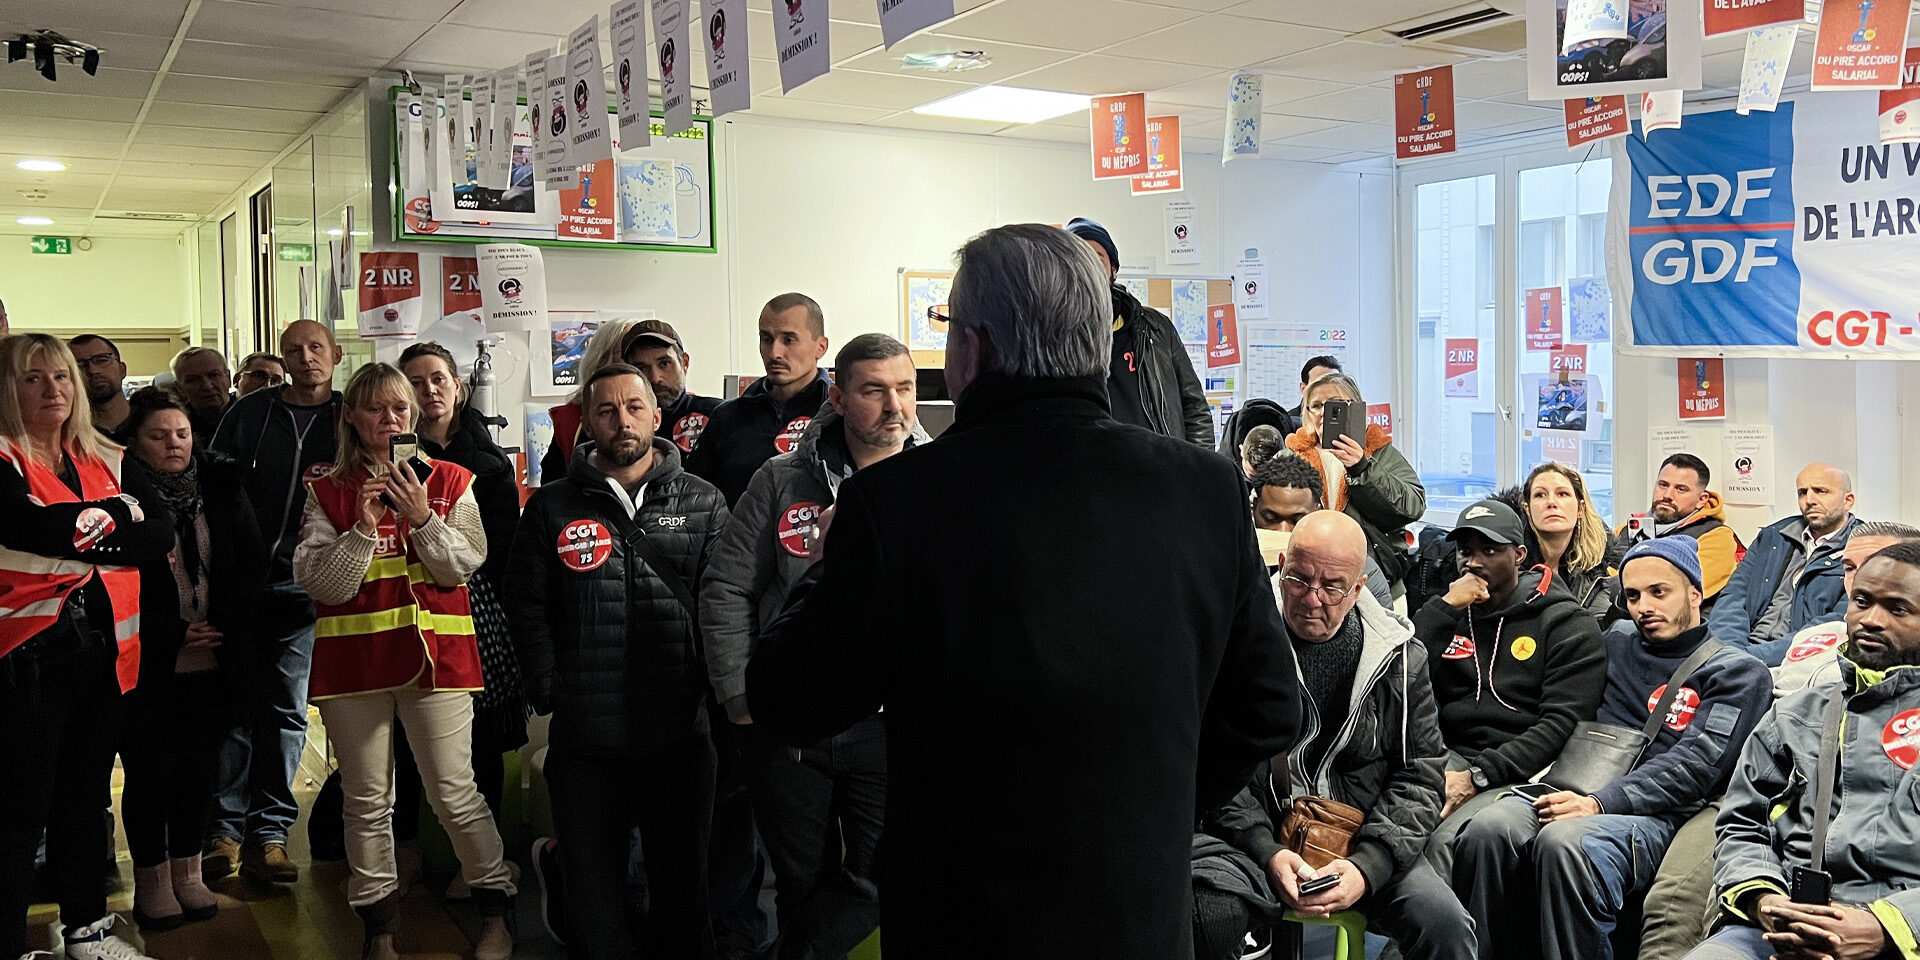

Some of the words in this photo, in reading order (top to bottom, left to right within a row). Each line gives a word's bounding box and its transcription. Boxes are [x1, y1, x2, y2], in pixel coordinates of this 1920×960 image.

[1817, 56, 1832, 65] DU
[1832, 55, 1855, 66] PIRE
[1856, 55, 1898, 66] ACCORD
[1560, 72, 1589, 83] OOPS!
[1832, 69, 1878, 80] SALARIAL
[1416, 76, 1432, 88] GRDF
[1110, 102, 1126, 113] GRDF
[1584, 104, 1602, 114] OSCAR
[1568, 121, 1577, 130] DU
[1578, 117, 1592, 128] PIRE
[1594, 108, 1624, 124] ACCORD
[1417, 124, 1434, 132] OSCAR
[1579, 123, 1612, 138] SALARIAL
[1409, 134, 1424, 142] PIRE
[1426, 130, 1452, 140] ACCORD
[1410, 142, 1442, 152] SALARIAL
[1102, 157, 1111, 169] DU
[1113, 153, 1140, 170] MÉPRIS
[1841, 144, 1890, 184] UN
[1648, 168, 1776, 218] EDF
[457, 200, 478, 208] OOPS!
[570, 216, 586, 224] PIRE
[1804, 204, 1838, 241] DE
[570, 226, 602, 234] SALARIAL
[1642, 238, 1778, 285] GDF
[364, 269, 377, 286] 2
[383, 268, 413, 286] NR
[449, 274, 462, 290] 2
[492, 310, 533, 319] DÉMISSION
[1807, 310, 1892, 347] CGT
[1320, 330, 1346, 340] 2022
[1448, 350, 1456, 362] 2
[1458, 350, 1474, 362] NR
[1553, 356, 1562, 370] 2
[1564, 356, 1582, 370] NR
[555, 376, 576, 384] OOPS!
[1695, 397, 1720, 412] MÉPRIS
[680, 415, 704, 429] CGT
[787, 420, 812, 430] CGT
[1374, 414, 1390, 426] NR
[788, 442, 799, 450] 75
[788, 506, 820, 524] CGT
[658, 516, 687, 527] GRDF
[566, 523, 599, 540] CGT
[580, 552, 593, 564] 75
